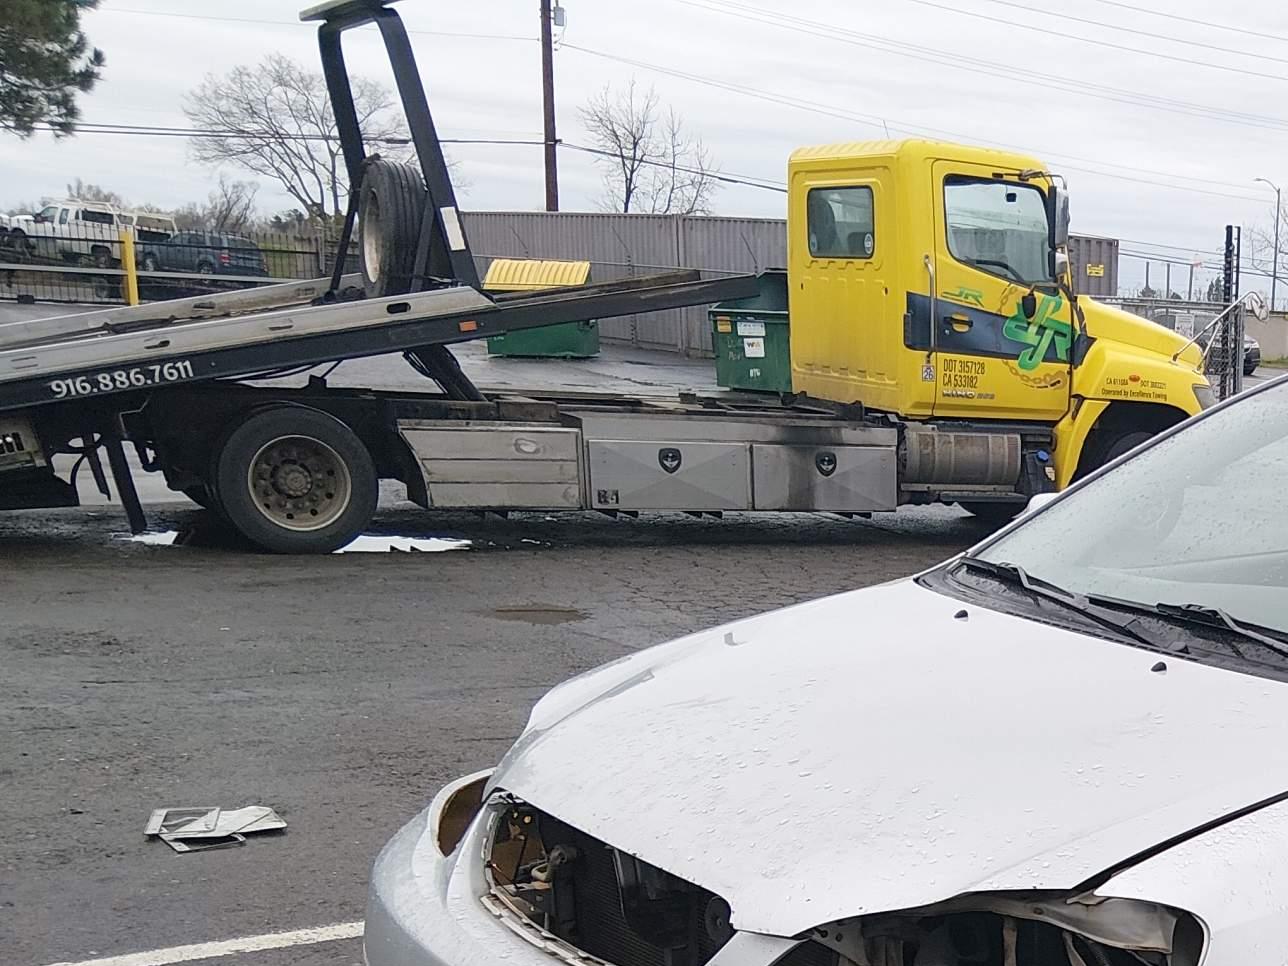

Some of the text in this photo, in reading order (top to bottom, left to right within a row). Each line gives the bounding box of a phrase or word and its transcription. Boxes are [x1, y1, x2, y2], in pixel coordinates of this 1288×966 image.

[943, 359, 985, 375] DOT 3157128
[50, 360, 194, 398] 916.886.7611
[943, 373, 978, 388] CA 533182
